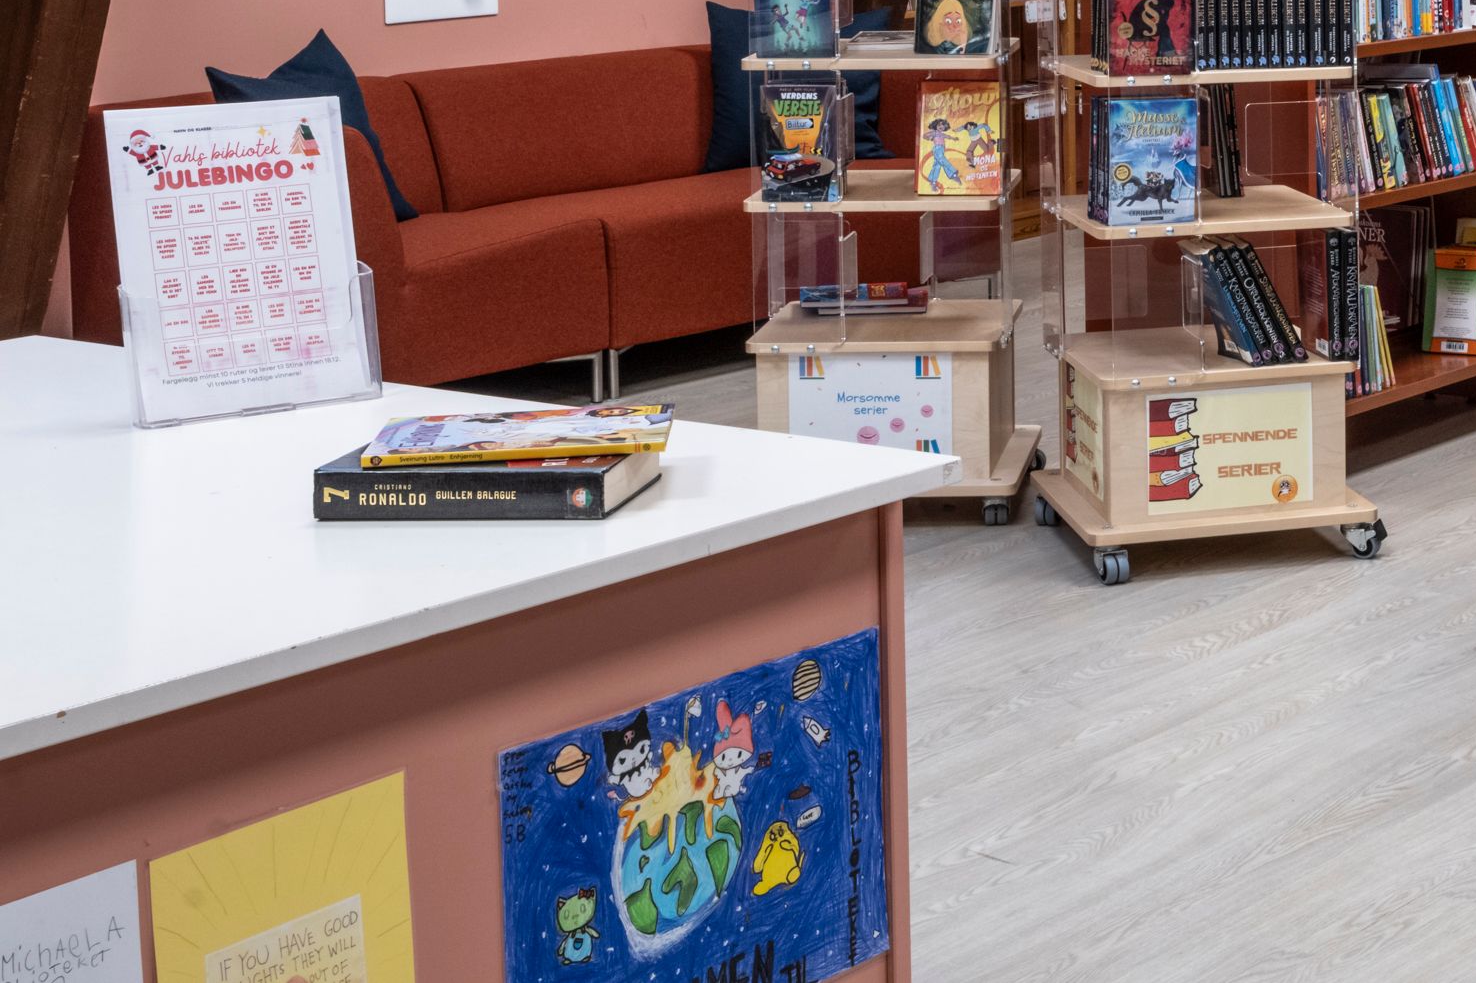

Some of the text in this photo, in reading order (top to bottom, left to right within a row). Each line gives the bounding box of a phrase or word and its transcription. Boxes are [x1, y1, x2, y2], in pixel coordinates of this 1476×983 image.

[781, 92, 818, 100] VERDENS
[773, 99, 821, 117] VERSTE
[162, 138, 281, 168] Vahls bibliotek
[973, 154, 996, 166] MONA
[153, 160, 294, 191] JULEBINGO
[162, 375, 198, 386] Fargelegg
[199, 372, 219, 380] minst
[229, 369, 247, 377] ruter
[248, 368, 258, 376] og
[285, 361, 303, 369] Stina
[215, 379, 240, 387] trekker
[247, 374, 273, 384] heldige
[837, 392, 900, 403] Morsomme
[1202, 428, 1298, 446] SPENNENDE
[449, 452, 483, 461] Enhjørning
[1217, 461, 1282, 479] SERIER
[359, 493, 427, 506] RONALDO
[435, 491, 473, 500] GUILLEM
[477, 490, 517, 500] BALAGUE
[219, 910, 359, 982] IF YOU HAVE GOOD
[292, 936, 357, 972] THEY WILL
[332, 959, 349, 976] OF
